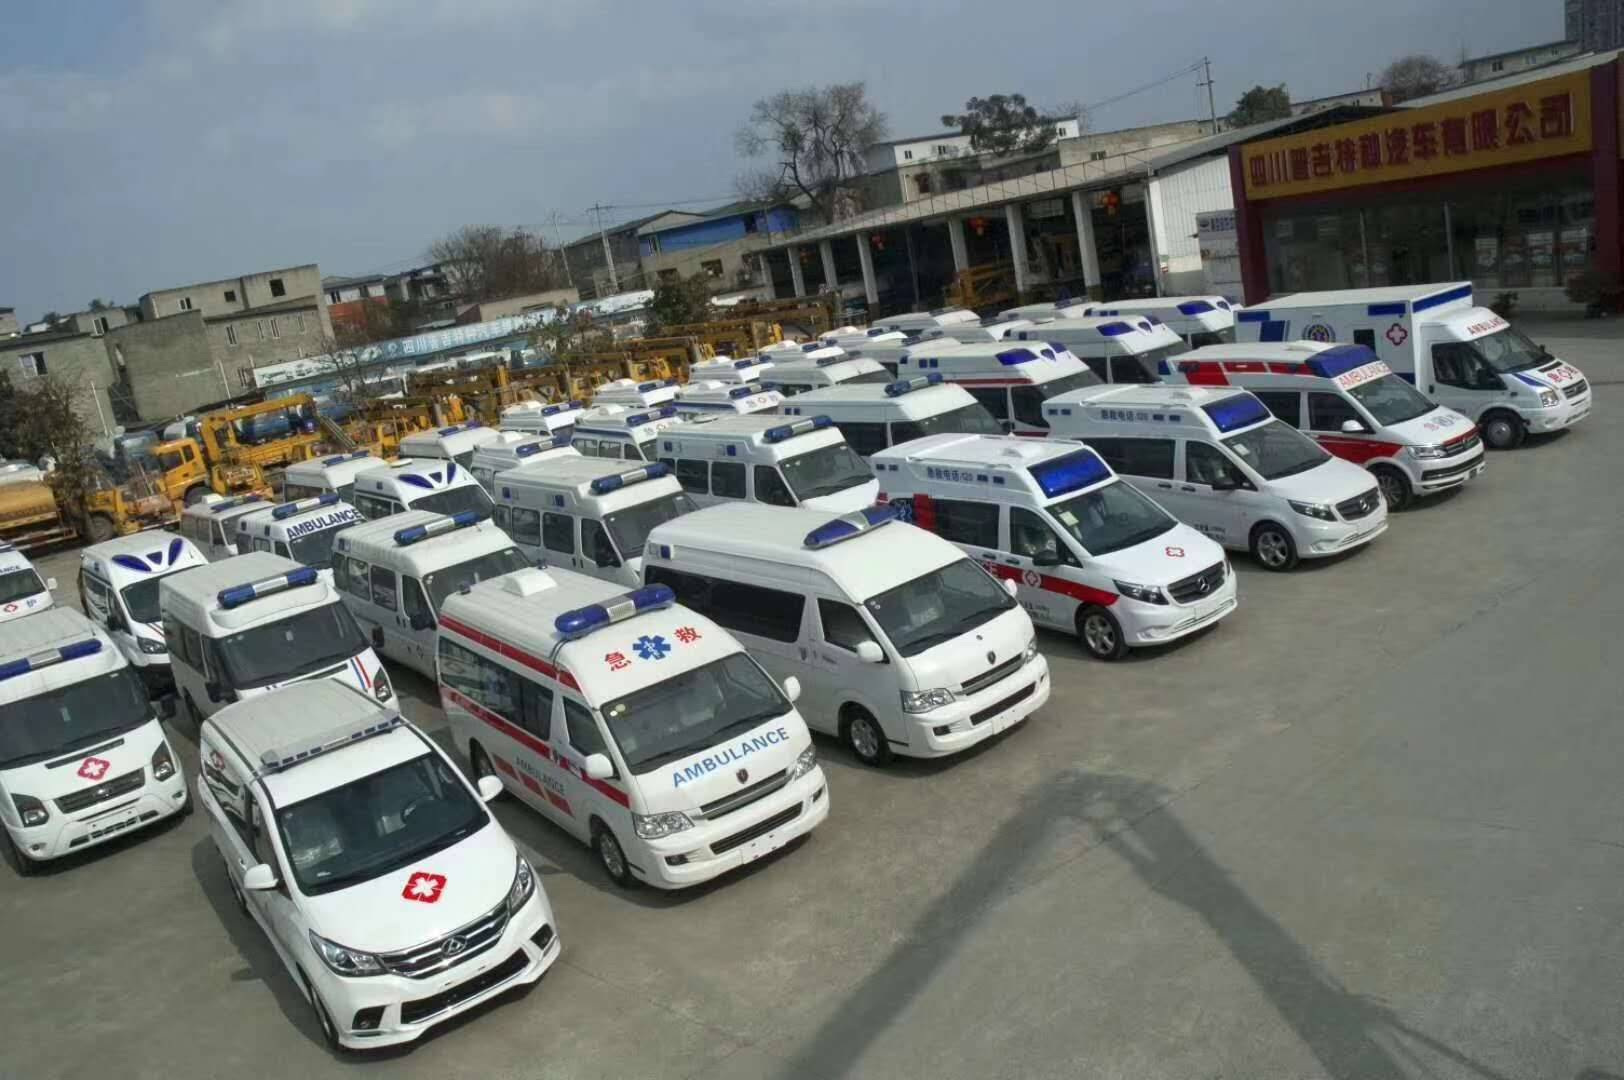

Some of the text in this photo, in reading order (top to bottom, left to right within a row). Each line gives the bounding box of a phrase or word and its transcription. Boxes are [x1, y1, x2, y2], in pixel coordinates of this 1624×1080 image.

[286, 508, 362, 539] AMBULANCE
[604, 626, 703, 671] 急 救
[673, 727, 790, 788] AMBULANCE
